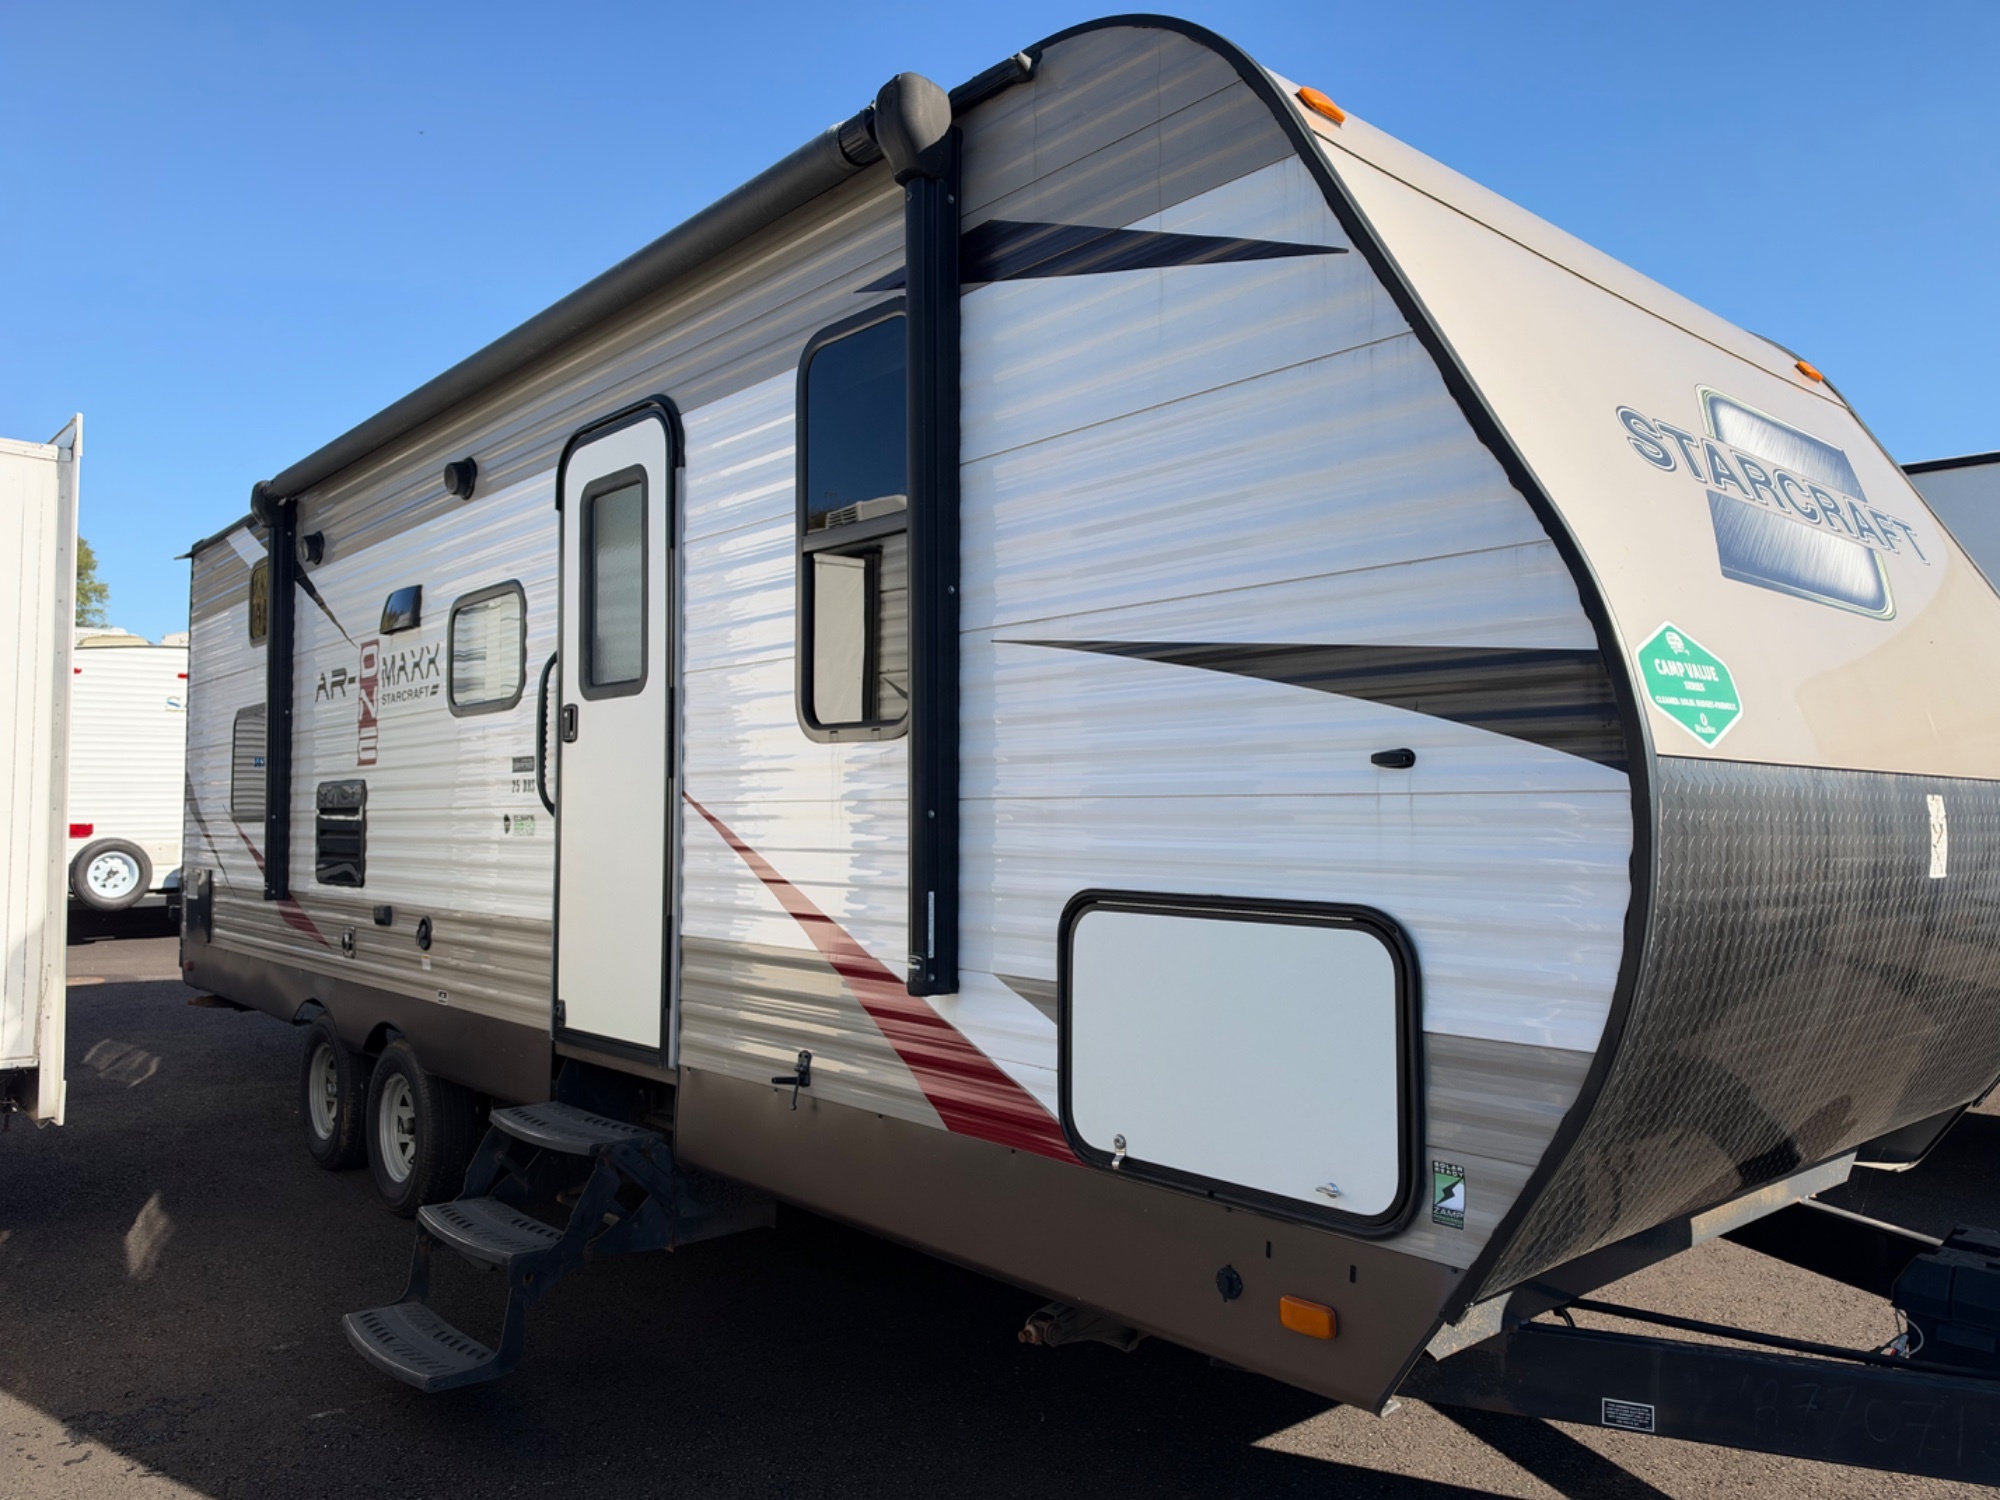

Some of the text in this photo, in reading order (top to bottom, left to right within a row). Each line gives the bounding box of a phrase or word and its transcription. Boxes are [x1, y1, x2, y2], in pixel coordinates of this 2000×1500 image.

[1615, 405, 1930, 566] STARCRAFT
[381, 642, 440, 689] MAXX
[1653, 658, 1719, 682] CAMP VALUE
[381, 685, 430, 706] STARCRAFT
